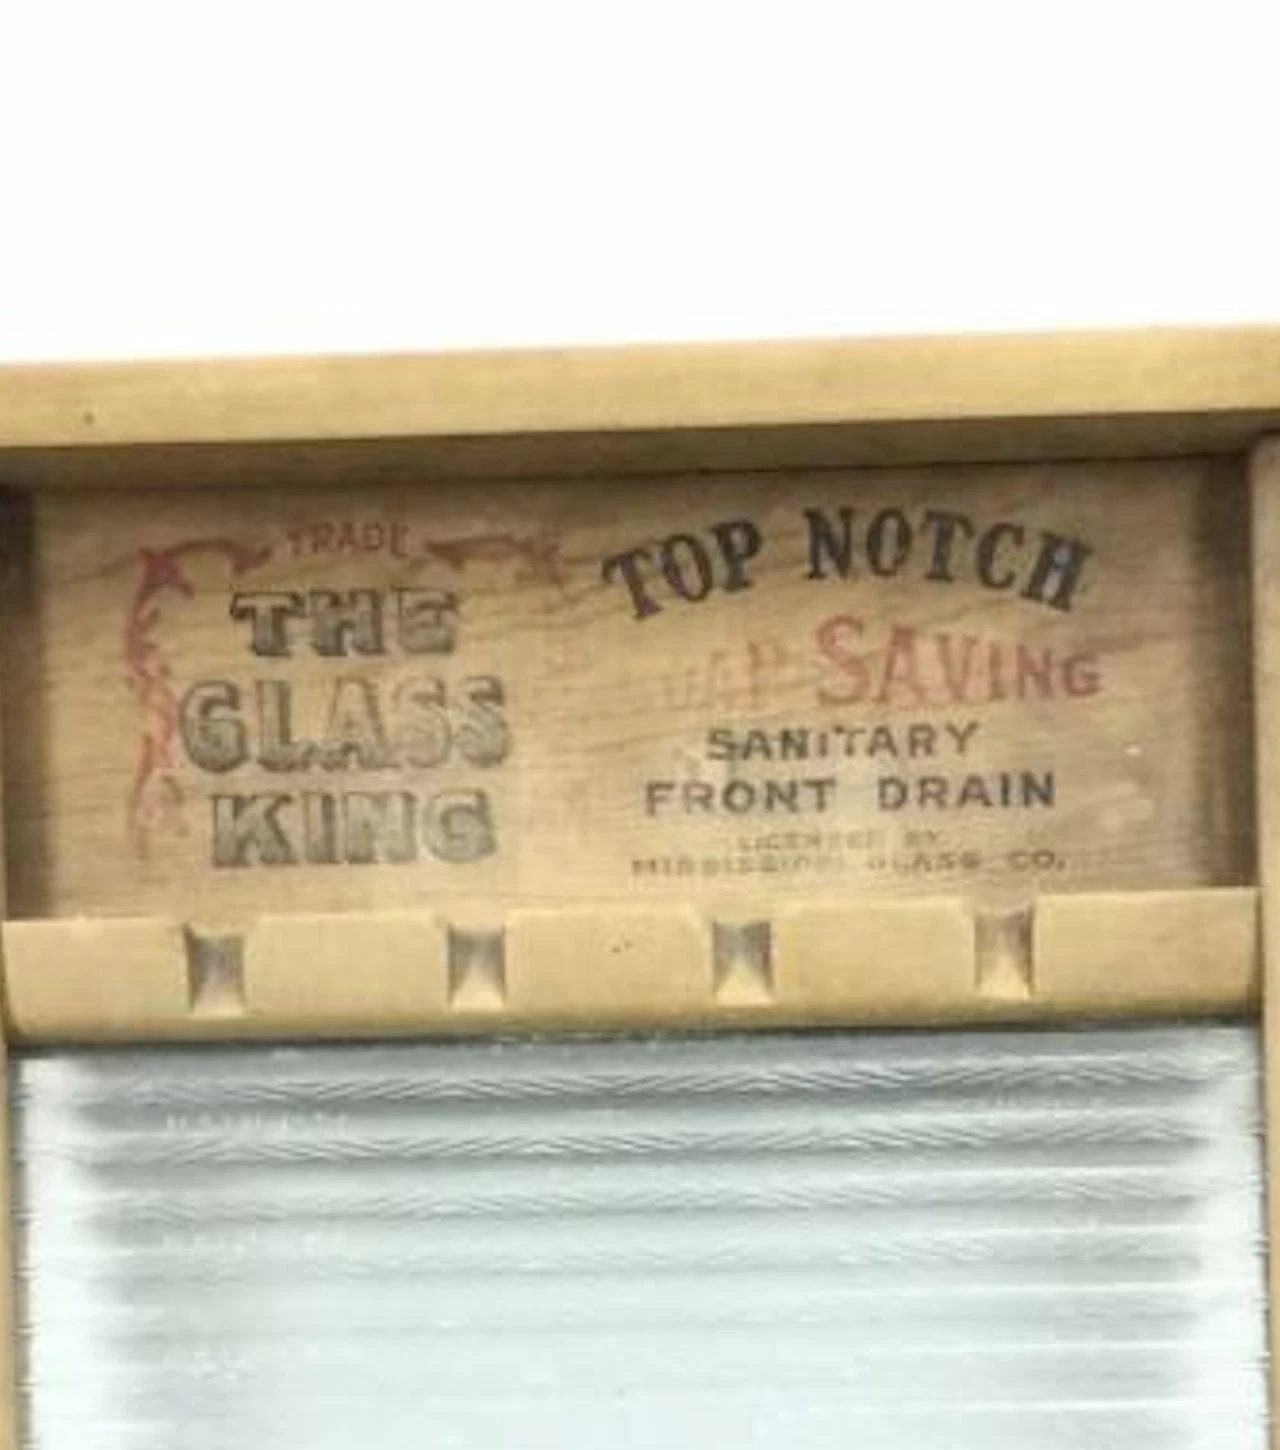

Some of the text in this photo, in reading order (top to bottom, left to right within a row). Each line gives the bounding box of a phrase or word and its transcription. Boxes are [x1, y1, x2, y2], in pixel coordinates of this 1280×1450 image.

[287, 520, 411, 560] TRADE
[600, 505, 1096, 622] TOP NOTCH
[231, 587, 460, 657] THE
[815, 614, 1102, 706] SAVING
[179, 674, 512, 773] GLASS
[706, 721, 980, 762] SANITARY
[211, 788, 500, 868] KING
[643, 771, 1056, 817] FRONT DRAIN
